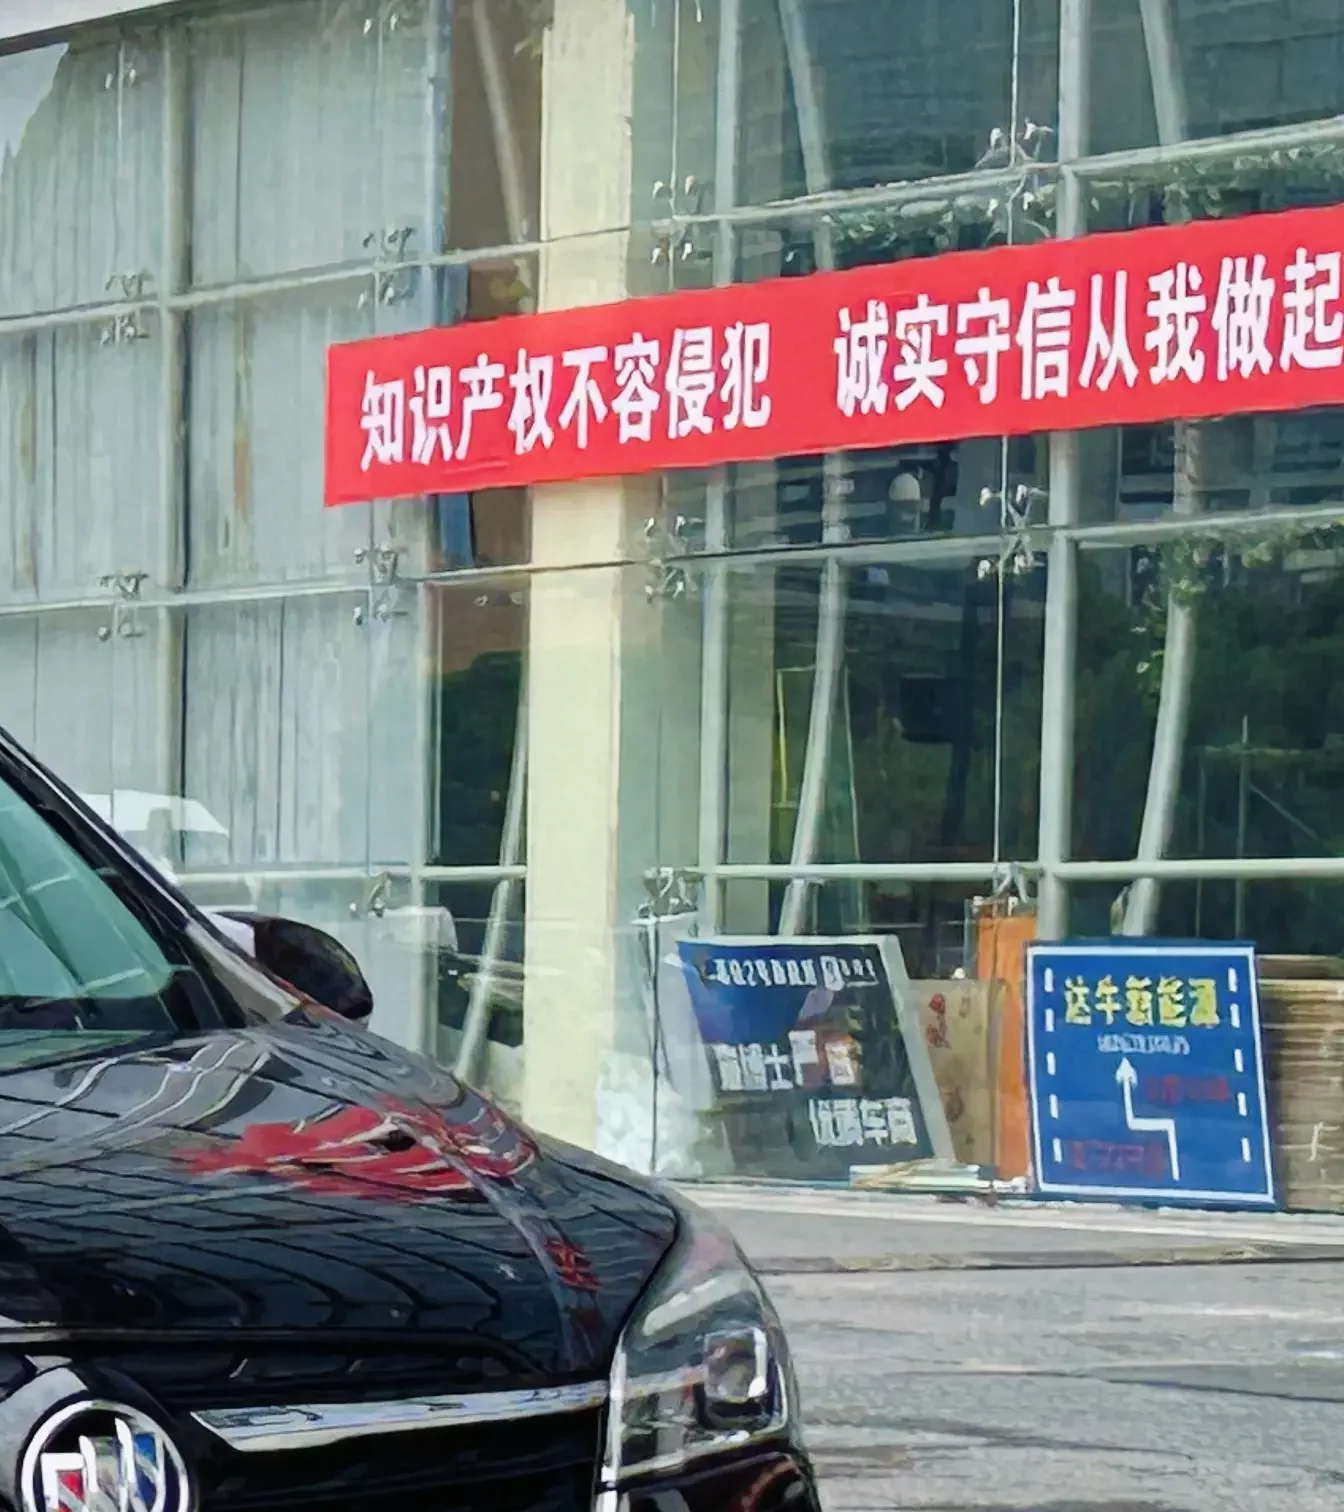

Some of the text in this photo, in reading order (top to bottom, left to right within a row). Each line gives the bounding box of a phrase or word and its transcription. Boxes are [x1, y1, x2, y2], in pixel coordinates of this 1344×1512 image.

[359, 247, 1344, 472] 知识产权不容侵犯 诚实守信从我做起
